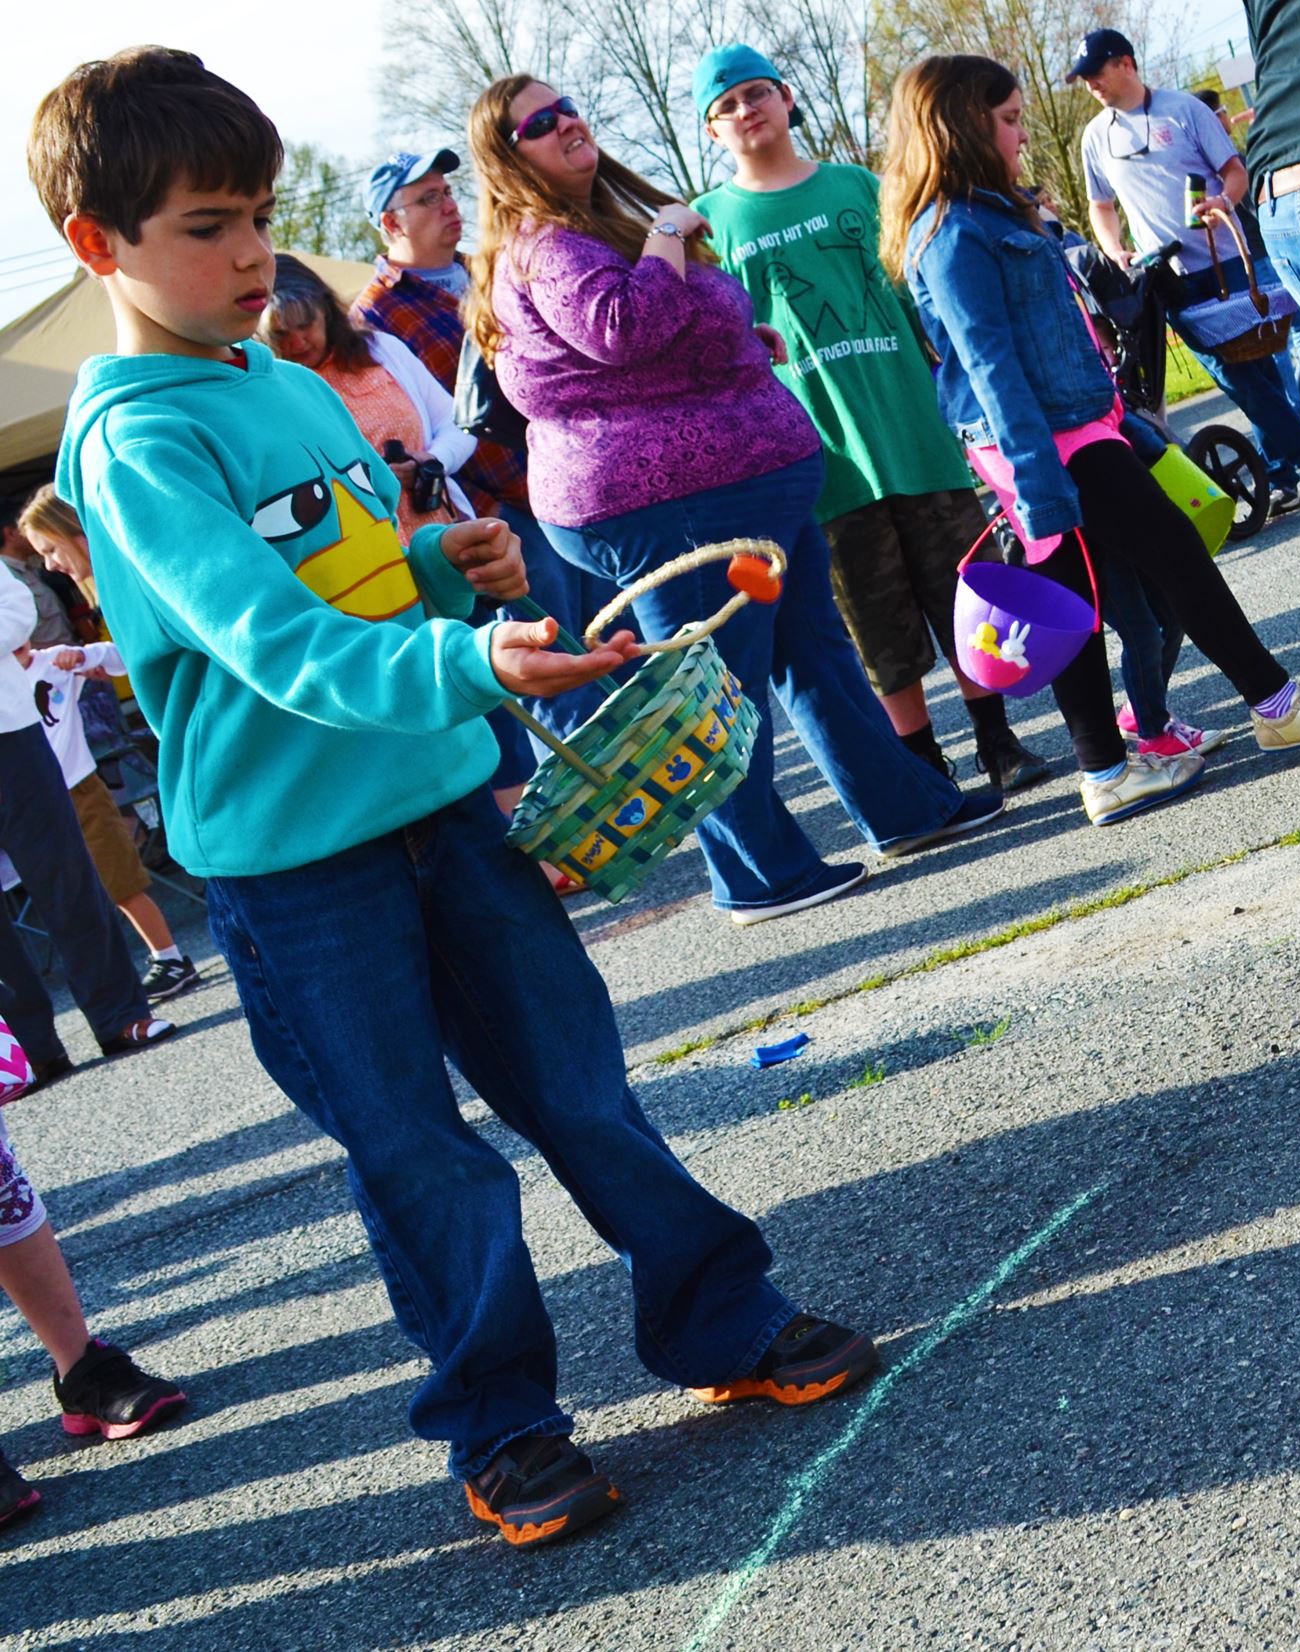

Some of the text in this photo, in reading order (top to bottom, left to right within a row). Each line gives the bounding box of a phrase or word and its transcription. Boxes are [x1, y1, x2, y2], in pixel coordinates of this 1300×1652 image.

[736, 241, 758, 261] DID
[757, 232, 781, 250] NOT
[782, 224, 802, 243] HIT
[803, 214, 829, 234] YOU
[816, 340, 852, 363] FIVED
[874, 336, 898, 352] FACE
